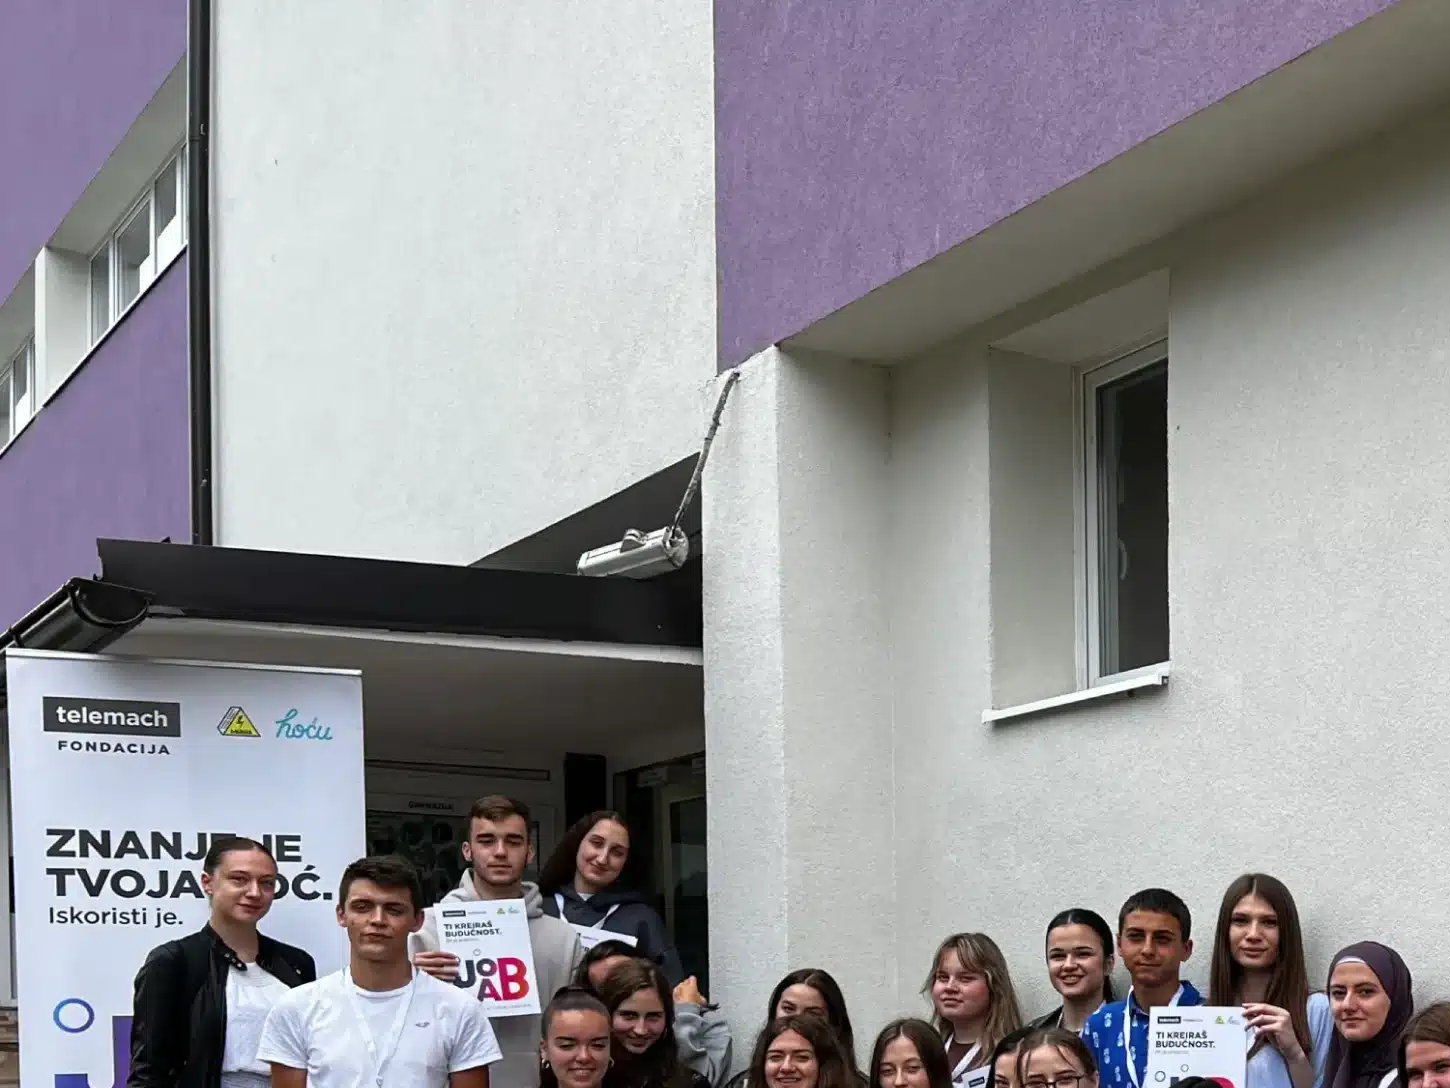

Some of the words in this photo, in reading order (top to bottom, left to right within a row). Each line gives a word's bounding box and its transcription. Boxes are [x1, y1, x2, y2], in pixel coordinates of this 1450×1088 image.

[56, 705, 168, 727] telemach
[275, 708, 333, 740] hoću
[57, 740, 170, 755] FONDACIJA
[46, 828, 237, 861] ZNANJ
[46, 867, 205, 899] TVOJA
[273, 864, 333, 901] OĆ.
[49, 906, 147, 924] Iskoristi
[154, 907, 183, 928] je.
[1155, 1039, 1216, 1048] BUDUĆNOST.
[1167, 1030, 1208, 1039] KREIRAŠ
